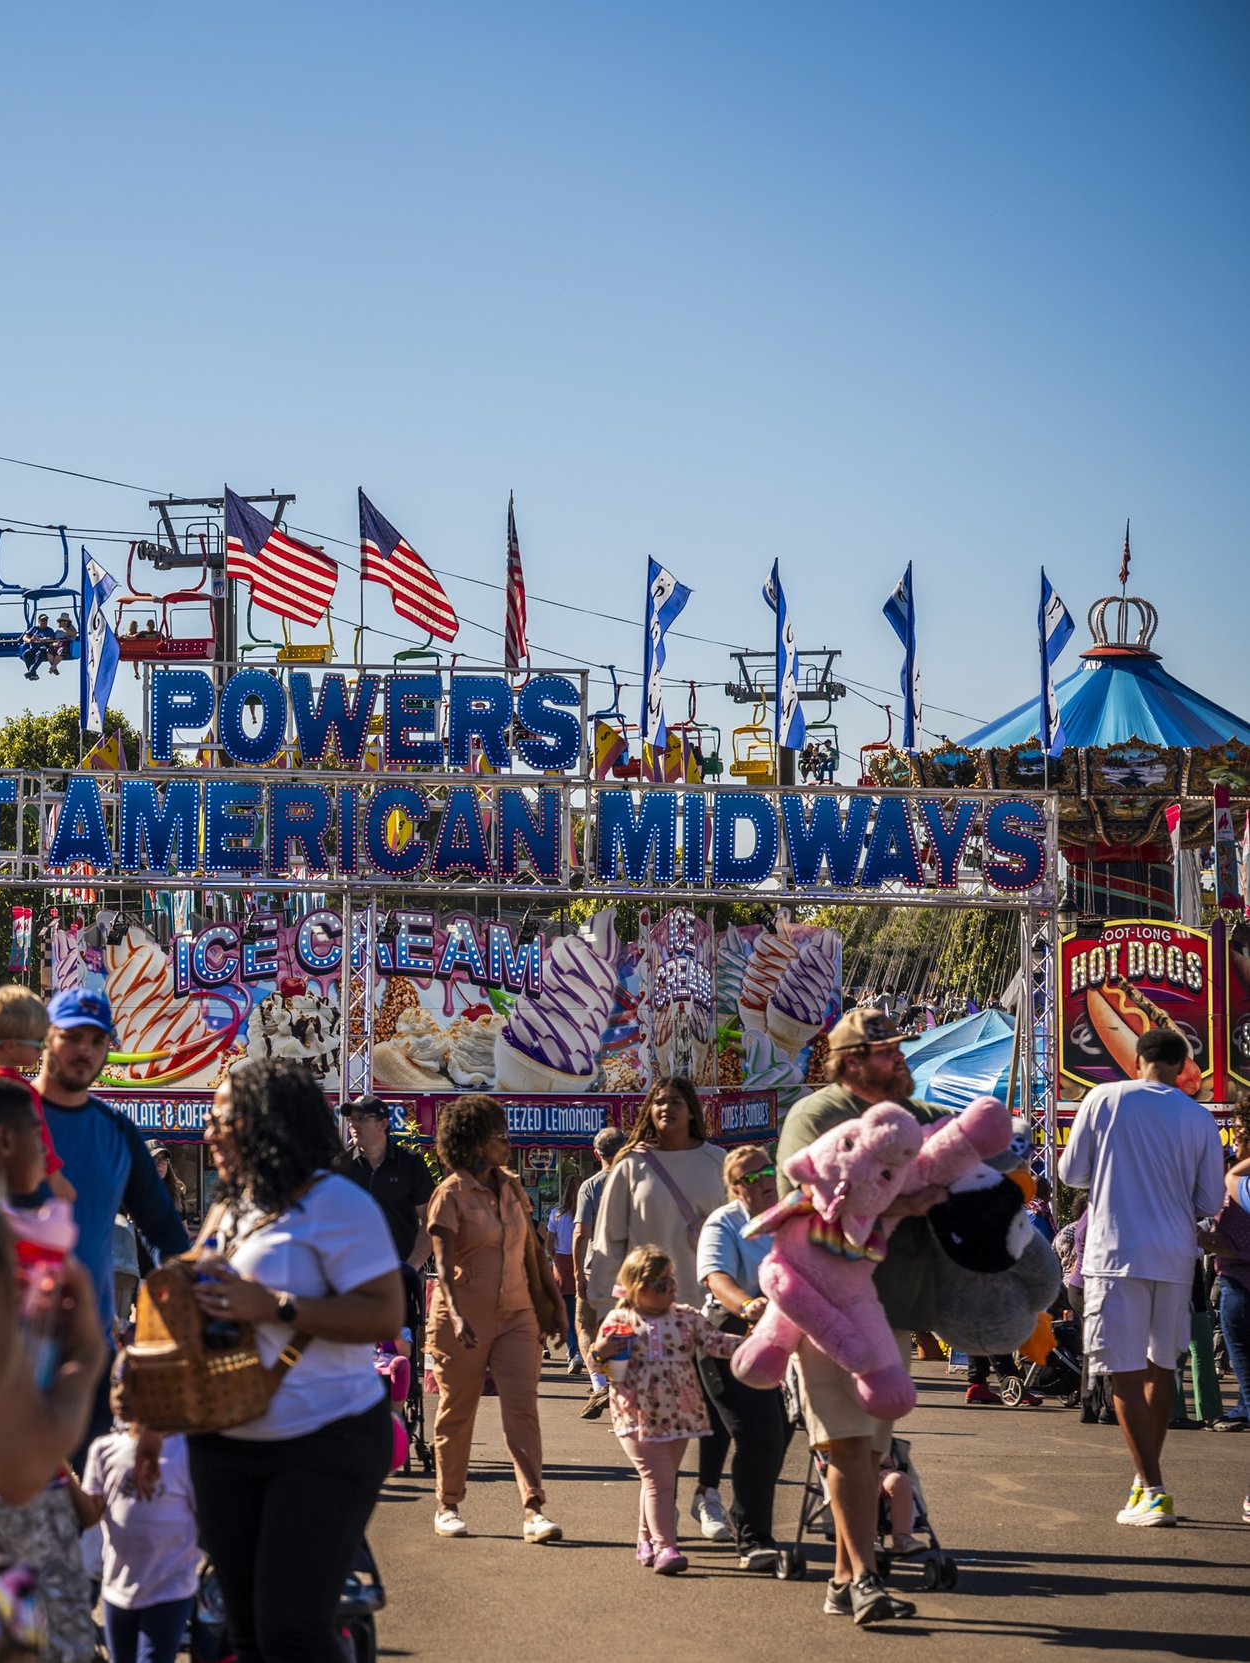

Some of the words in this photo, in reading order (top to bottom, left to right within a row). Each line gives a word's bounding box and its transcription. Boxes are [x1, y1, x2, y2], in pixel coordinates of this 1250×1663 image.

[151, 669, 582, 770] POWERS
[48, 777, 561, 880] AMERICAN
[596, 789, 1048, 892] MIDWAYS
[174, 911, 279, 996] ICE
[296, 908, 542, 996] CREAM
[668, 907, 696, 954] ICE
[654, 957, 711, 1008] CREAM
[1069, 942, 1121, 994] HOT
[1127, 941, 1203, 990] DOGS
[165, 1103, 174, 1126] &
[545, 1107, 605, 1131] LEMONADE
